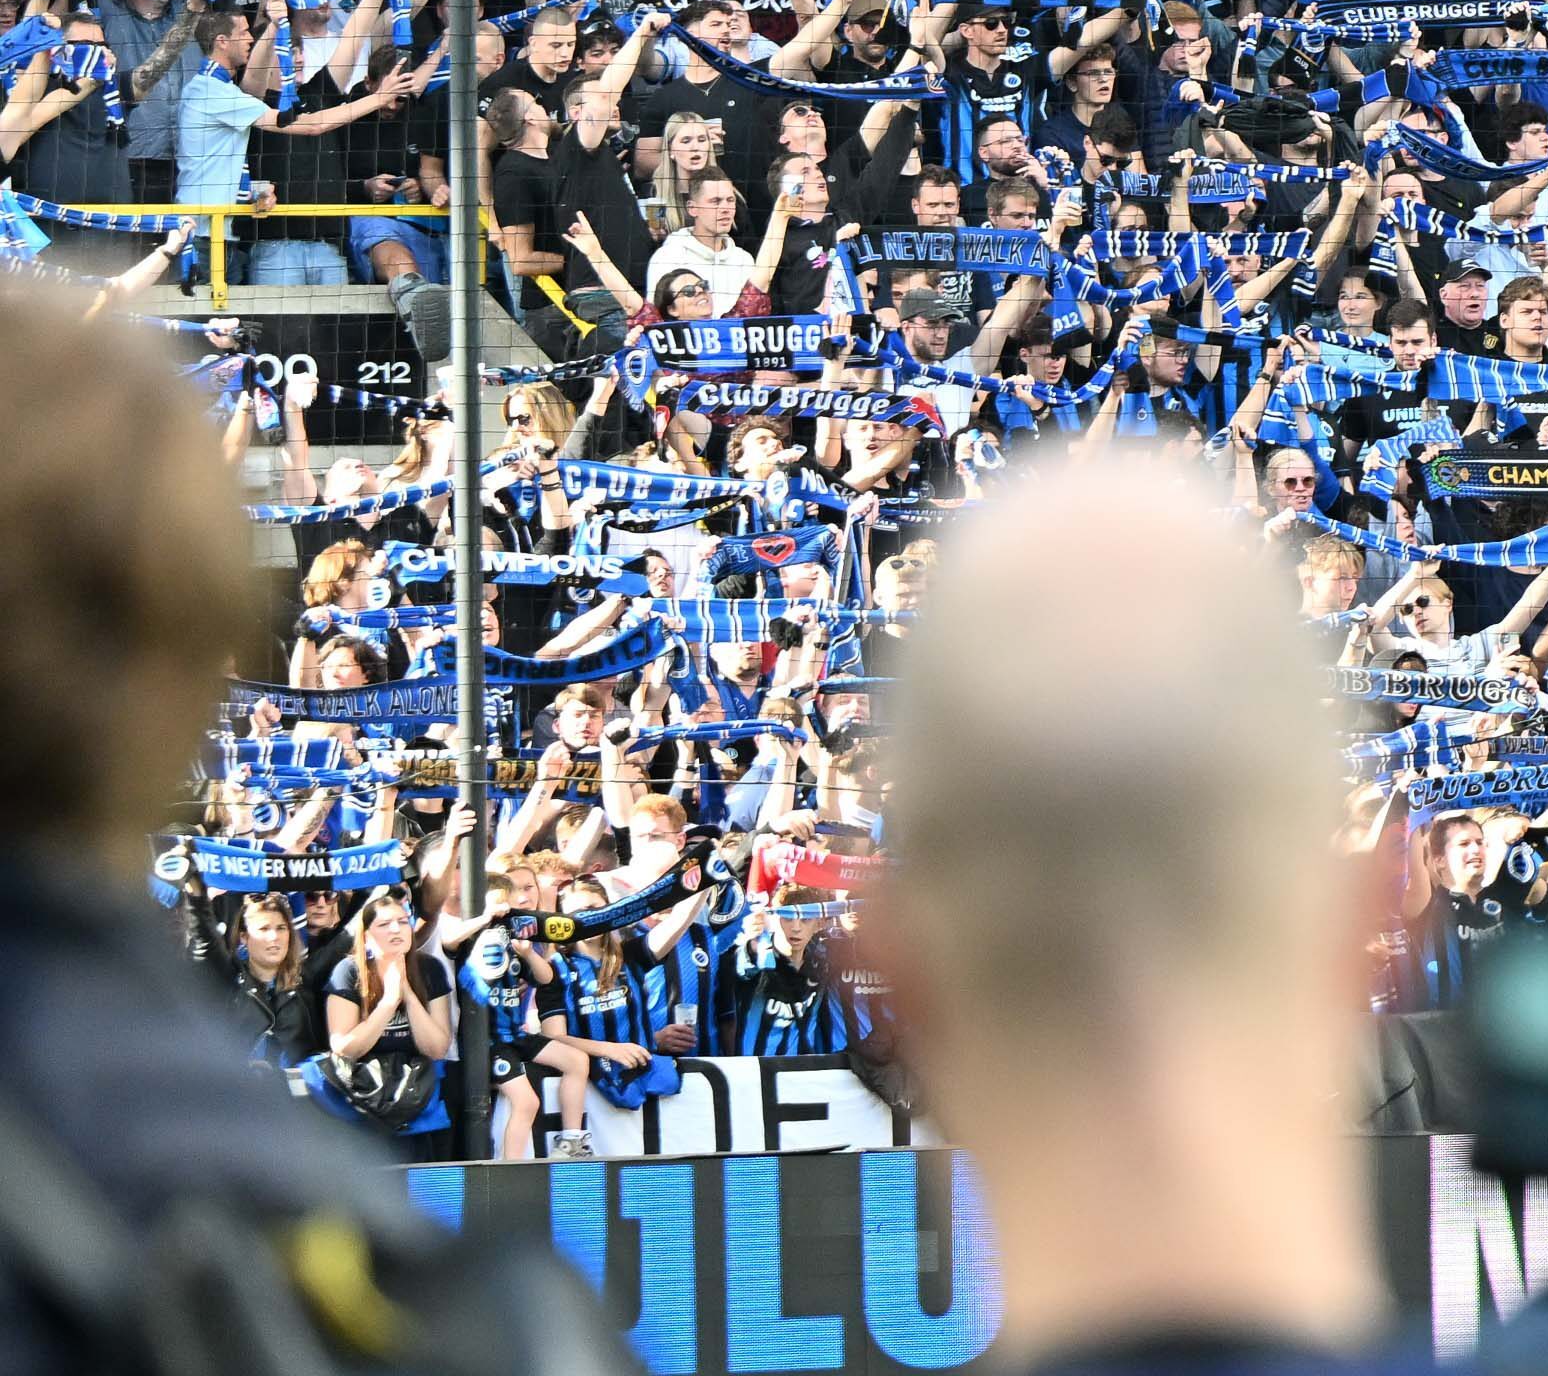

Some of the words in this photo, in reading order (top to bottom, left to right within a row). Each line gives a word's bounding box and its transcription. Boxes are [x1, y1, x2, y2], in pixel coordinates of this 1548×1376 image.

[1345, 4, 1395, 25] CLUB
[652, 323, 716, 355] CLUB
[359, 360, 411, 383] 212
[698, 381, 765, 411] Club
[770, 384, 892, 419] Brugge
